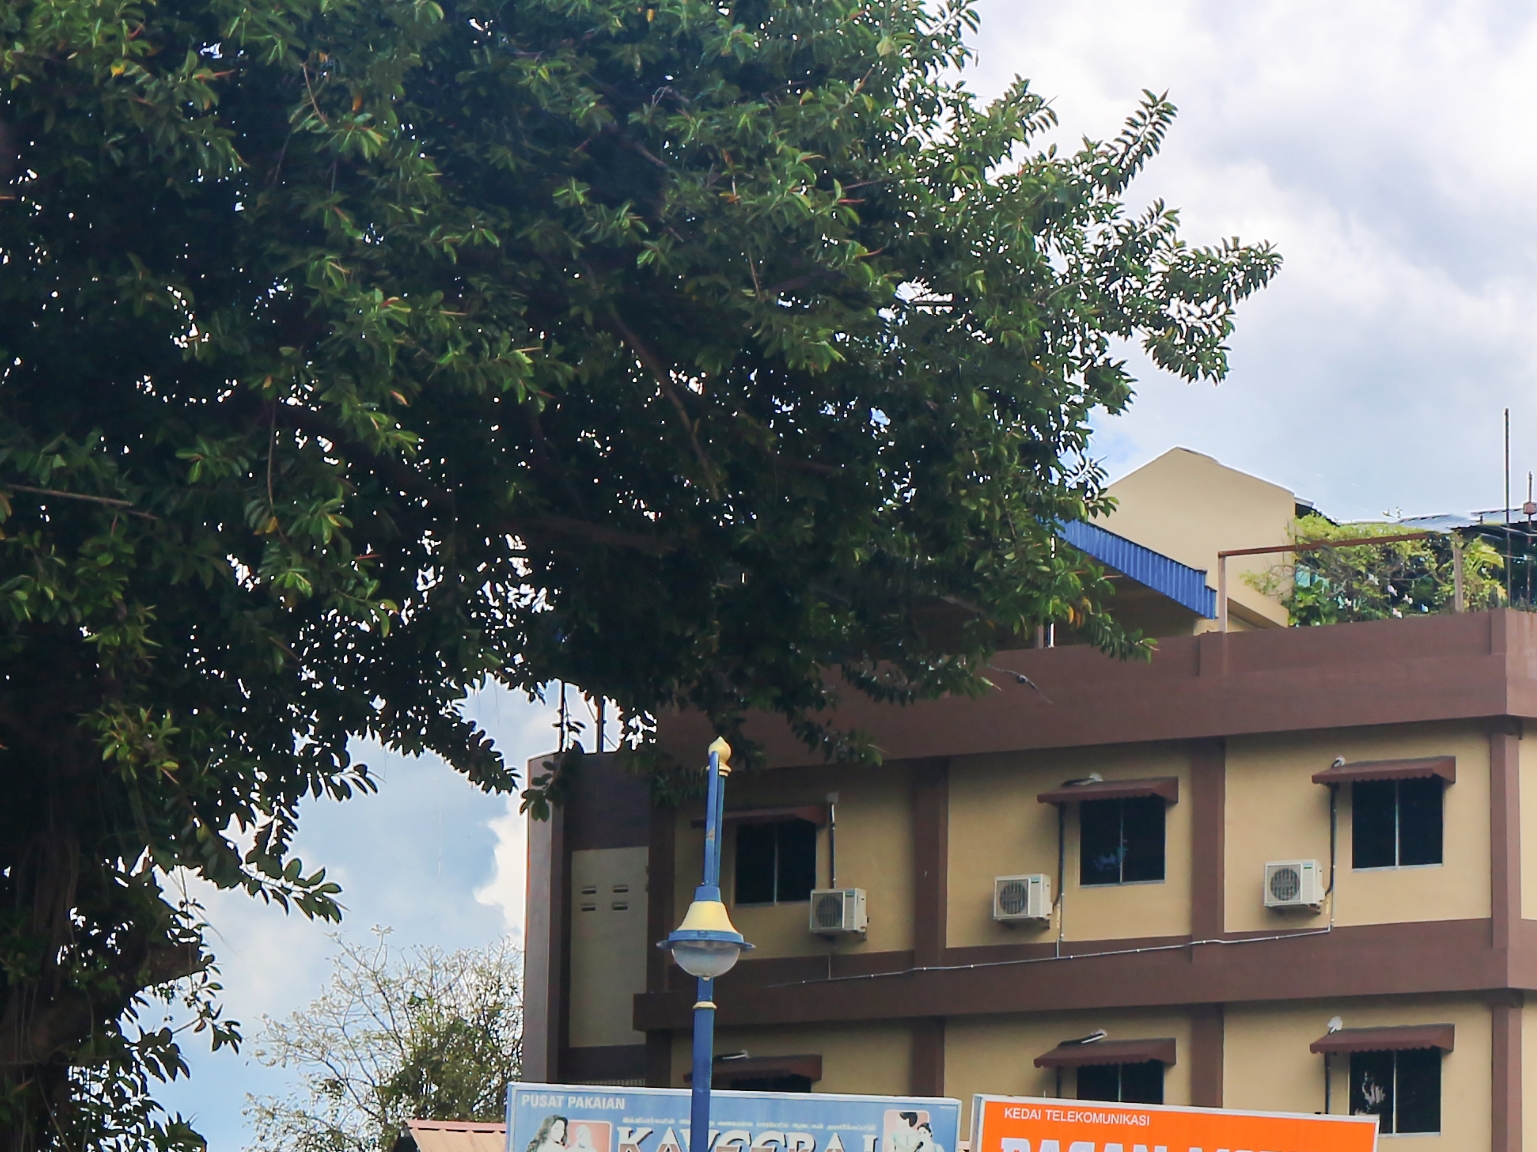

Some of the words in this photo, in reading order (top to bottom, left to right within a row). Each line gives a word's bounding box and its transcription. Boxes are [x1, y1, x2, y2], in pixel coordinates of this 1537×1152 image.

[522, 1095, 563, 1109] PUSAT
[568, 1096, 625, 1110] PAKAIAN
[1004, 1108, 1041, 1120] KEDAI
[1045, 1109, 1150, 1126] TELEKOMUNIKASI
